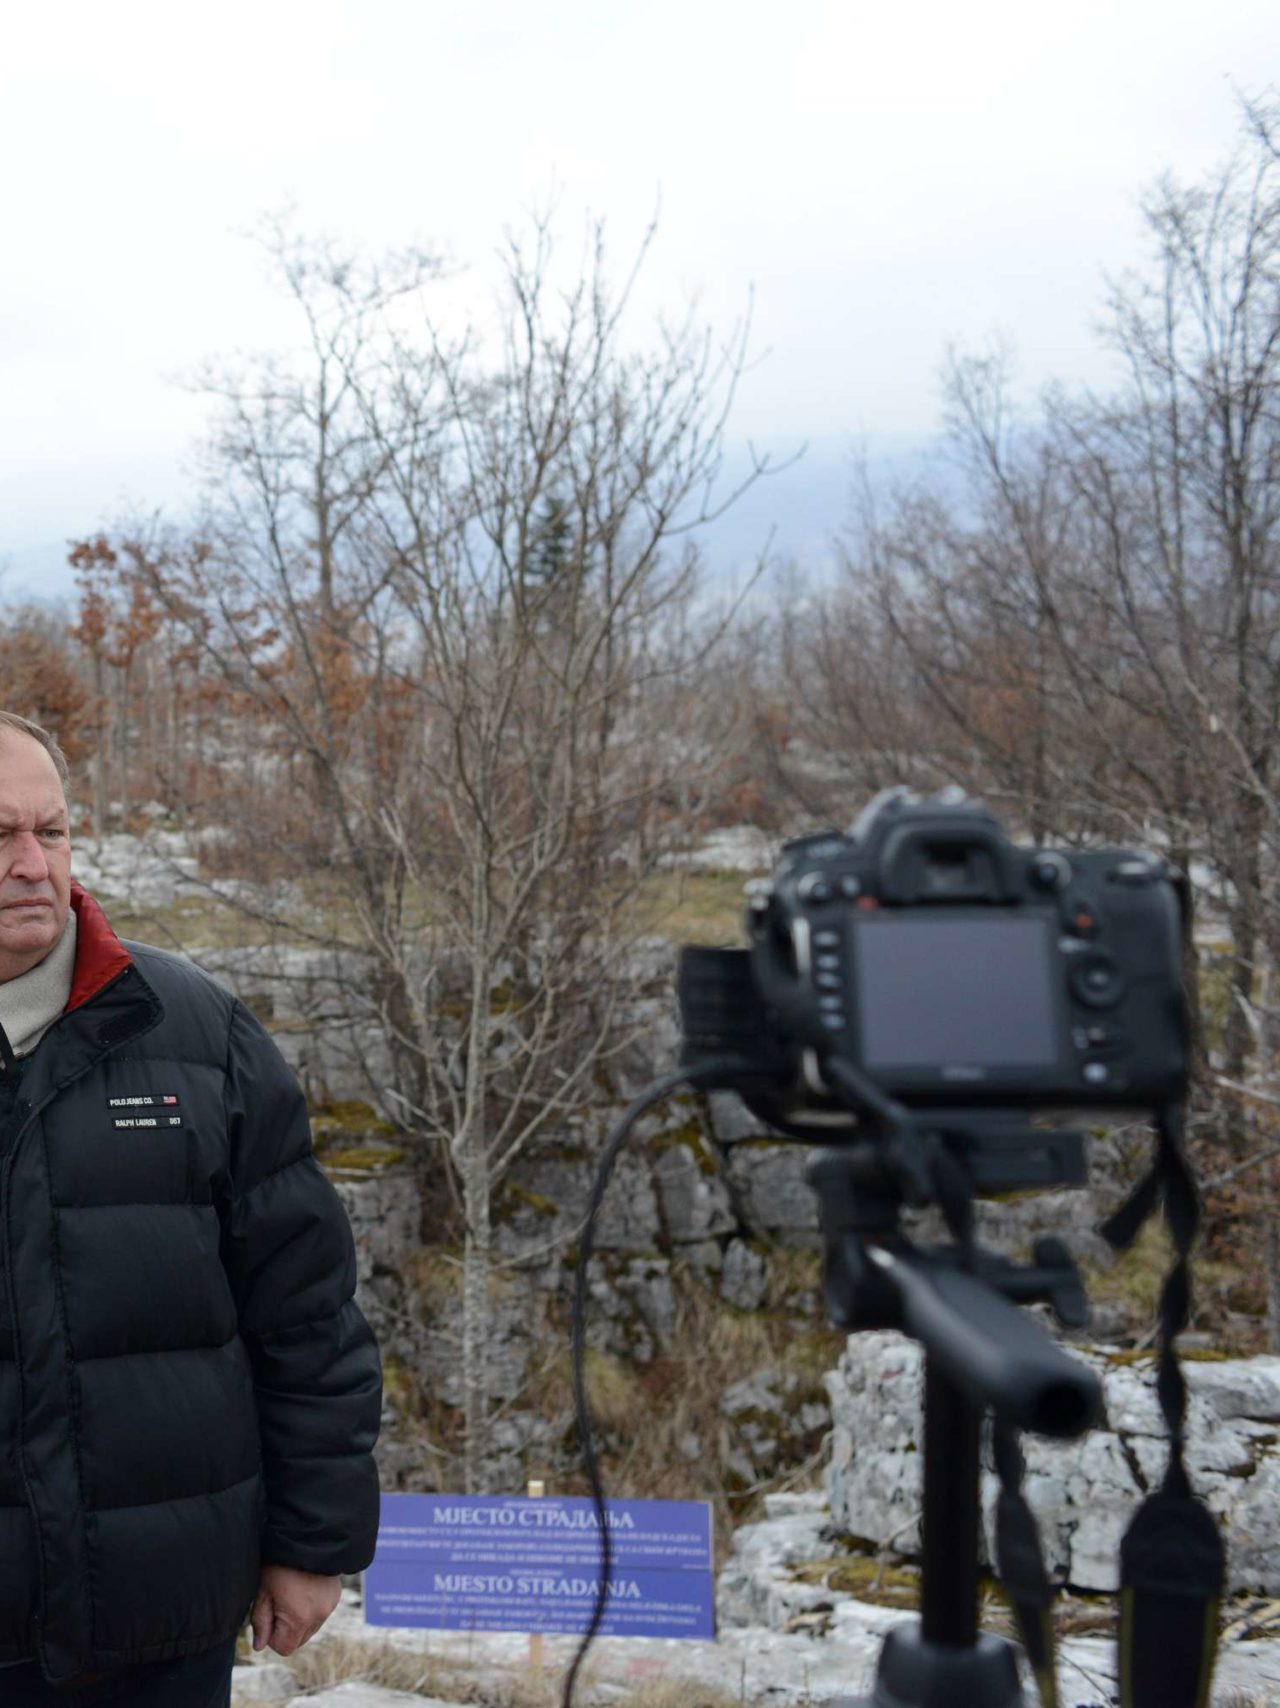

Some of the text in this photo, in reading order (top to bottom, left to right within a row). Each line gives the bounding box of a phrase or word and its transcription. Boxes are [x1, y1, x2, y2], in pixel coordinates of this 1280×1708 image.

[135, 1118, 156, 1126] LAUREN
[433, 1507, 515, 1526] МЈЕСТО
[434, 1573, 513, 1594] MJESTO
